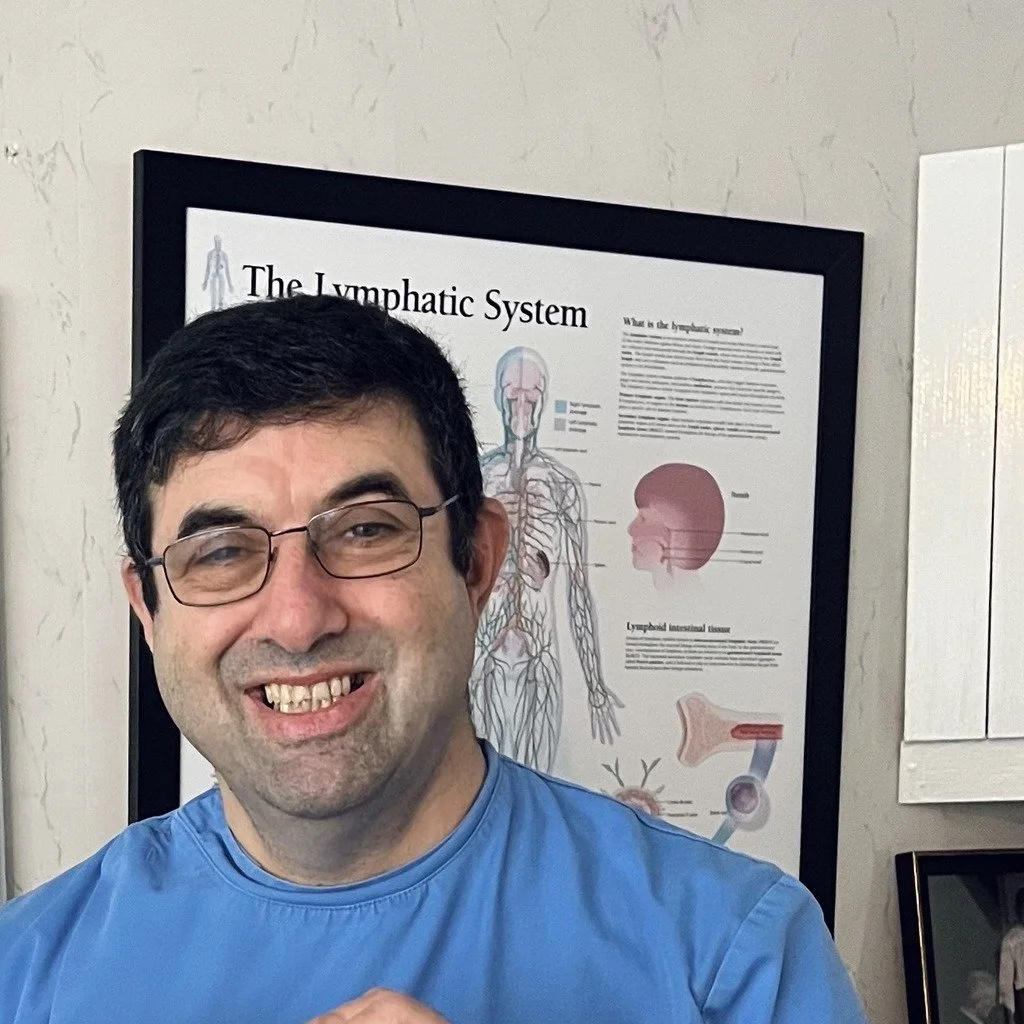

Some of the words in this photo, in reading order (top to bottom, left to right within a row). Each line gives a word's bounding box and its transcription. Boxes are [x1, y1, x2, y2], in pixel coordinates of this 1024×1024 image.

[242, 264, 303, 299] The
[484, 288, 589, 332] System
[626, 621, 667, 634] Lymphoid
